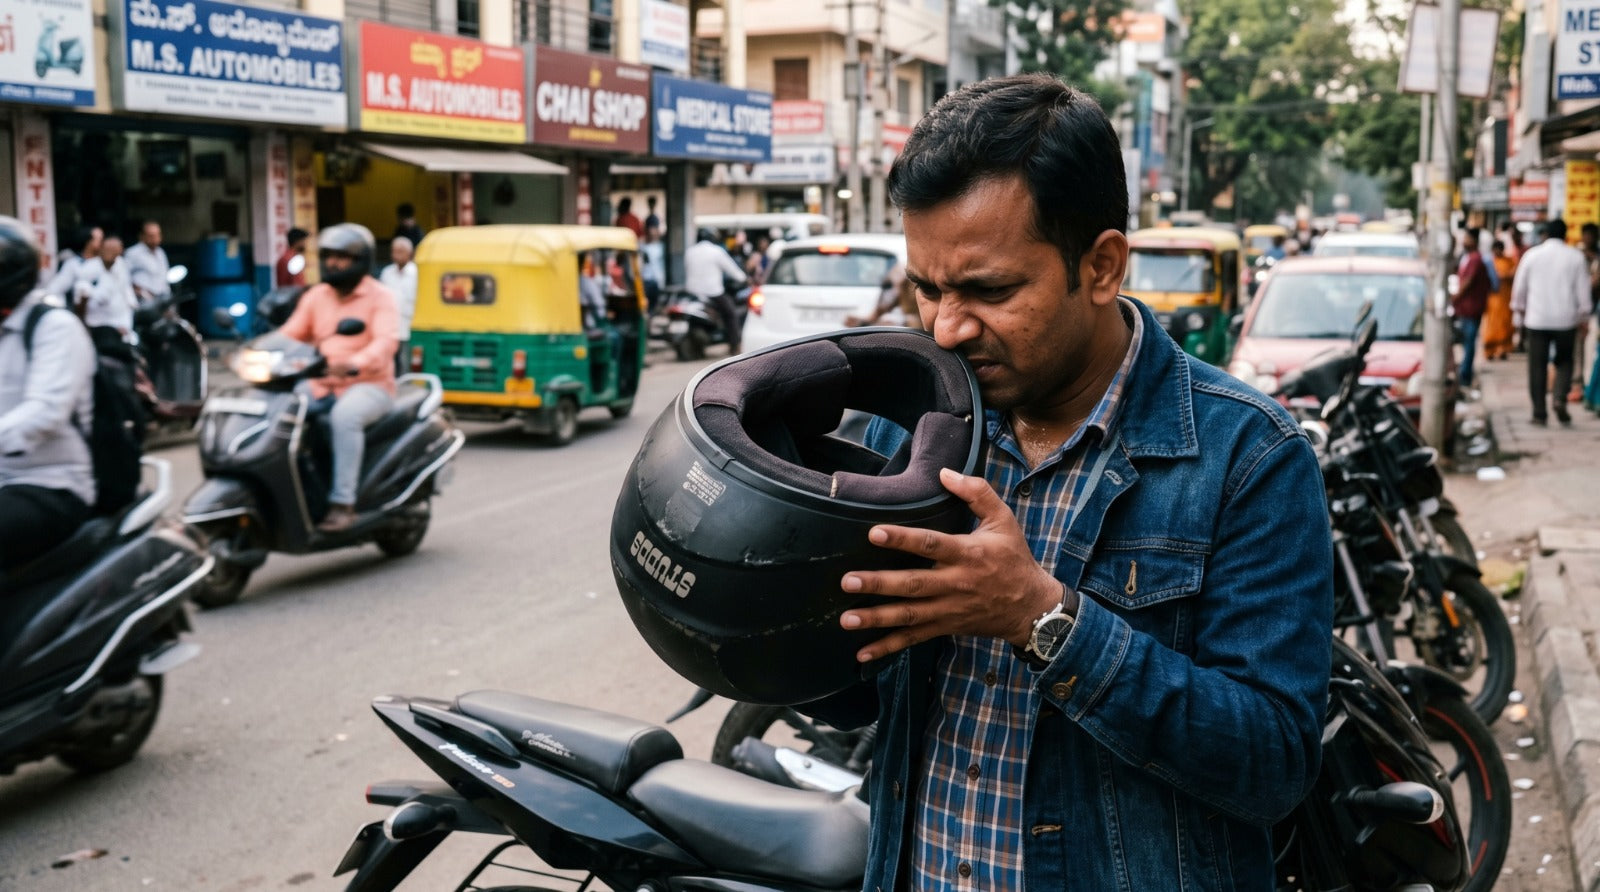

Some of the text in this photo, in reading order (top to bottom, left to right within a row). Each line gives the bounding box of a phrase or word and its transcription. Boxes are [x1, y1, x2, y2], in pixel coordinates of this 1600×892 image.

[131, 39, 341, 90] M.S. AUTOMOBILES
[366, 71, 406, 107] M.S.
[408, 77, 522, 121] AUTOMOBILES
[536, 81, 648, 131] CHAI SHOP
[676, 96, 732, 133] MEDICAL
[630, 530, 696, 598] STUDDS
